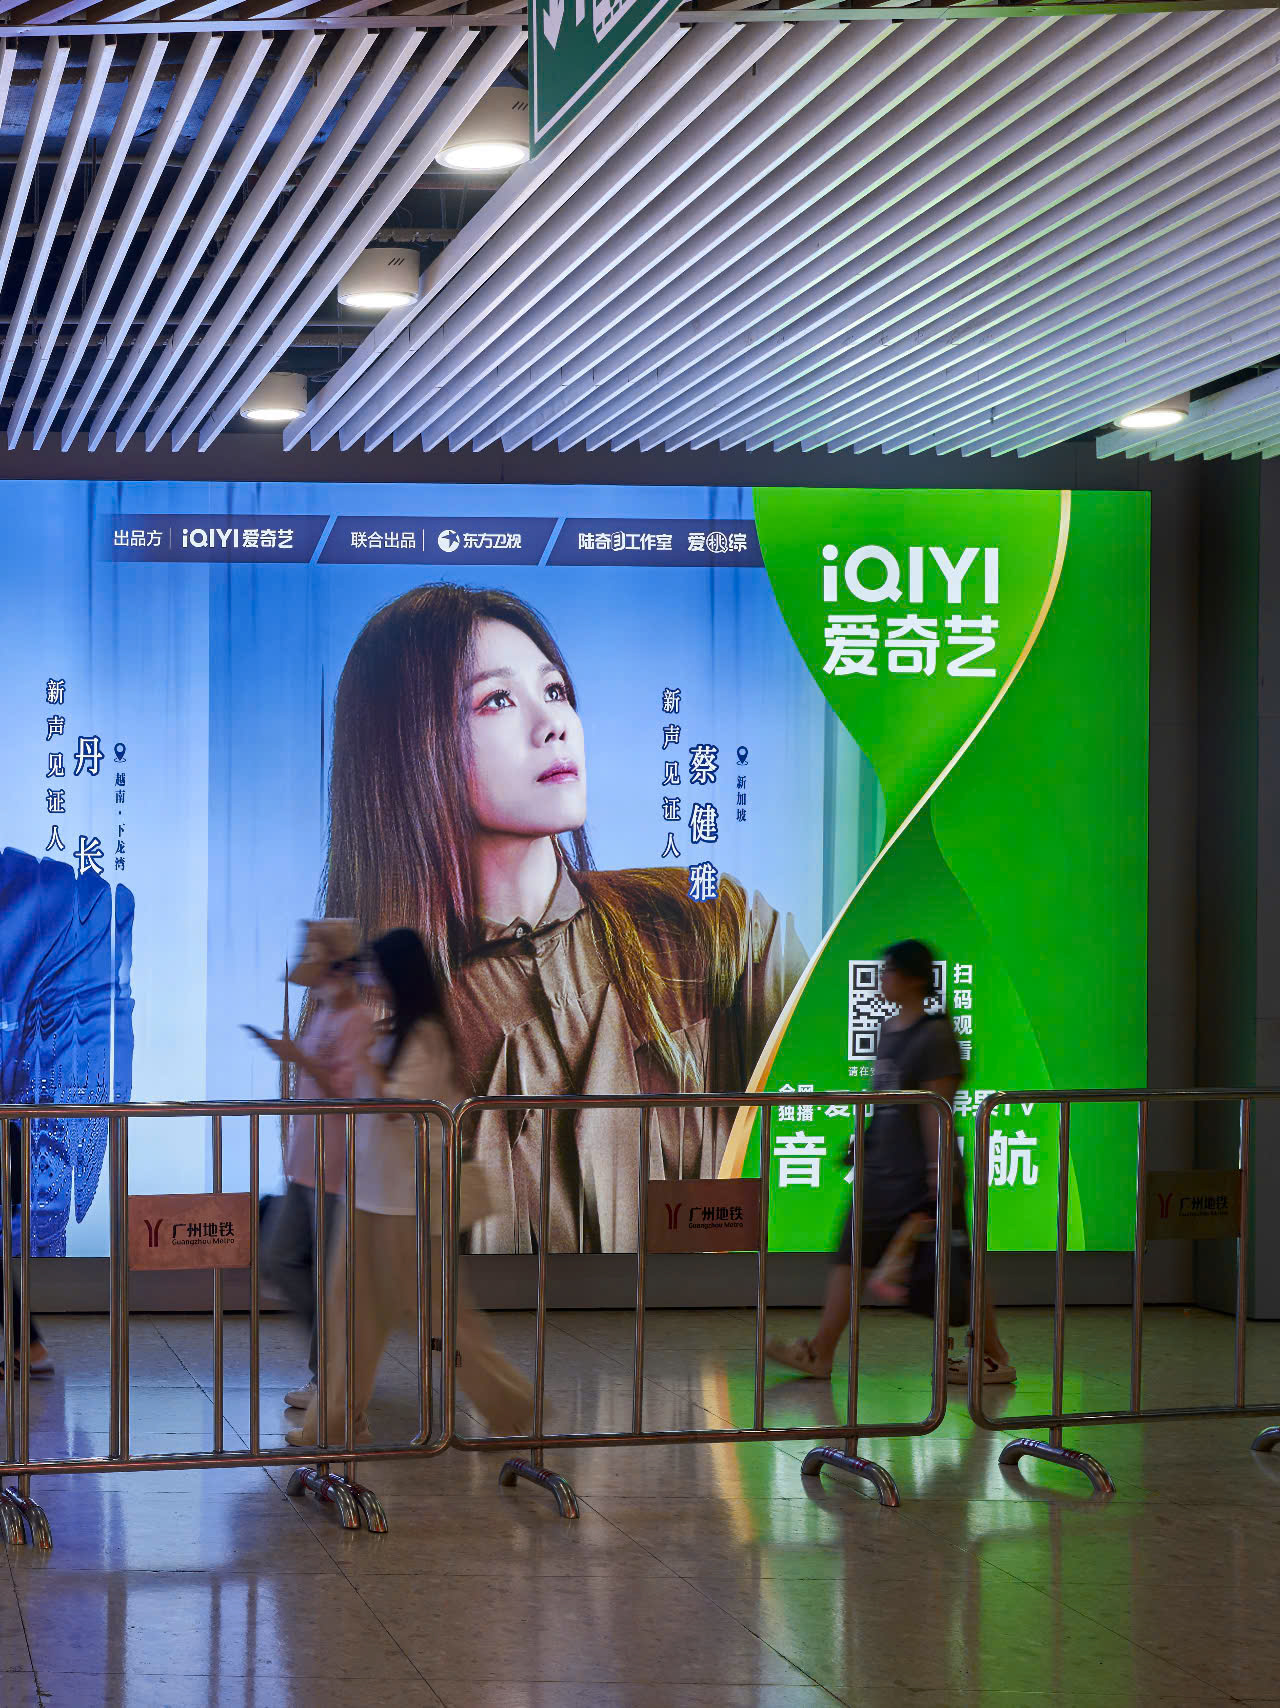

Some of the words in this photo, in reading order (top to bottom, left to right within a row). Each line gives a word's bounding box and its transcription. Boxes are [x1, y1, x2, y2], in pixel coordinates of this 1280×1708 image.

[113, 529, 163, 548] 出品方
[182, 528, 239, 549] iQIYI
[242, 528, 294, 549] 爱奇艺
[350, 531, 417, 550] 联合出品
[462, 532, 522, 549] 东方卫视
[822, 544, 999, 604] iQIYI
[822, 614, 999, 678] 爱奇艺
[46, 678, 66, 851] 新声见证人
[661, 688, 681, 858] 新声见证人
[736, 775, 747, 822] 新加坡
[689, 744, 719, 902] 蔡健雅
[688, 1206, 743, 1222] 广州地铁
[172, 1221, 235, 1239] 广州地铁
[688, 1221, 723, 1230] Guangzhou
[171, 1237, 211, 1246] Guangzhou
